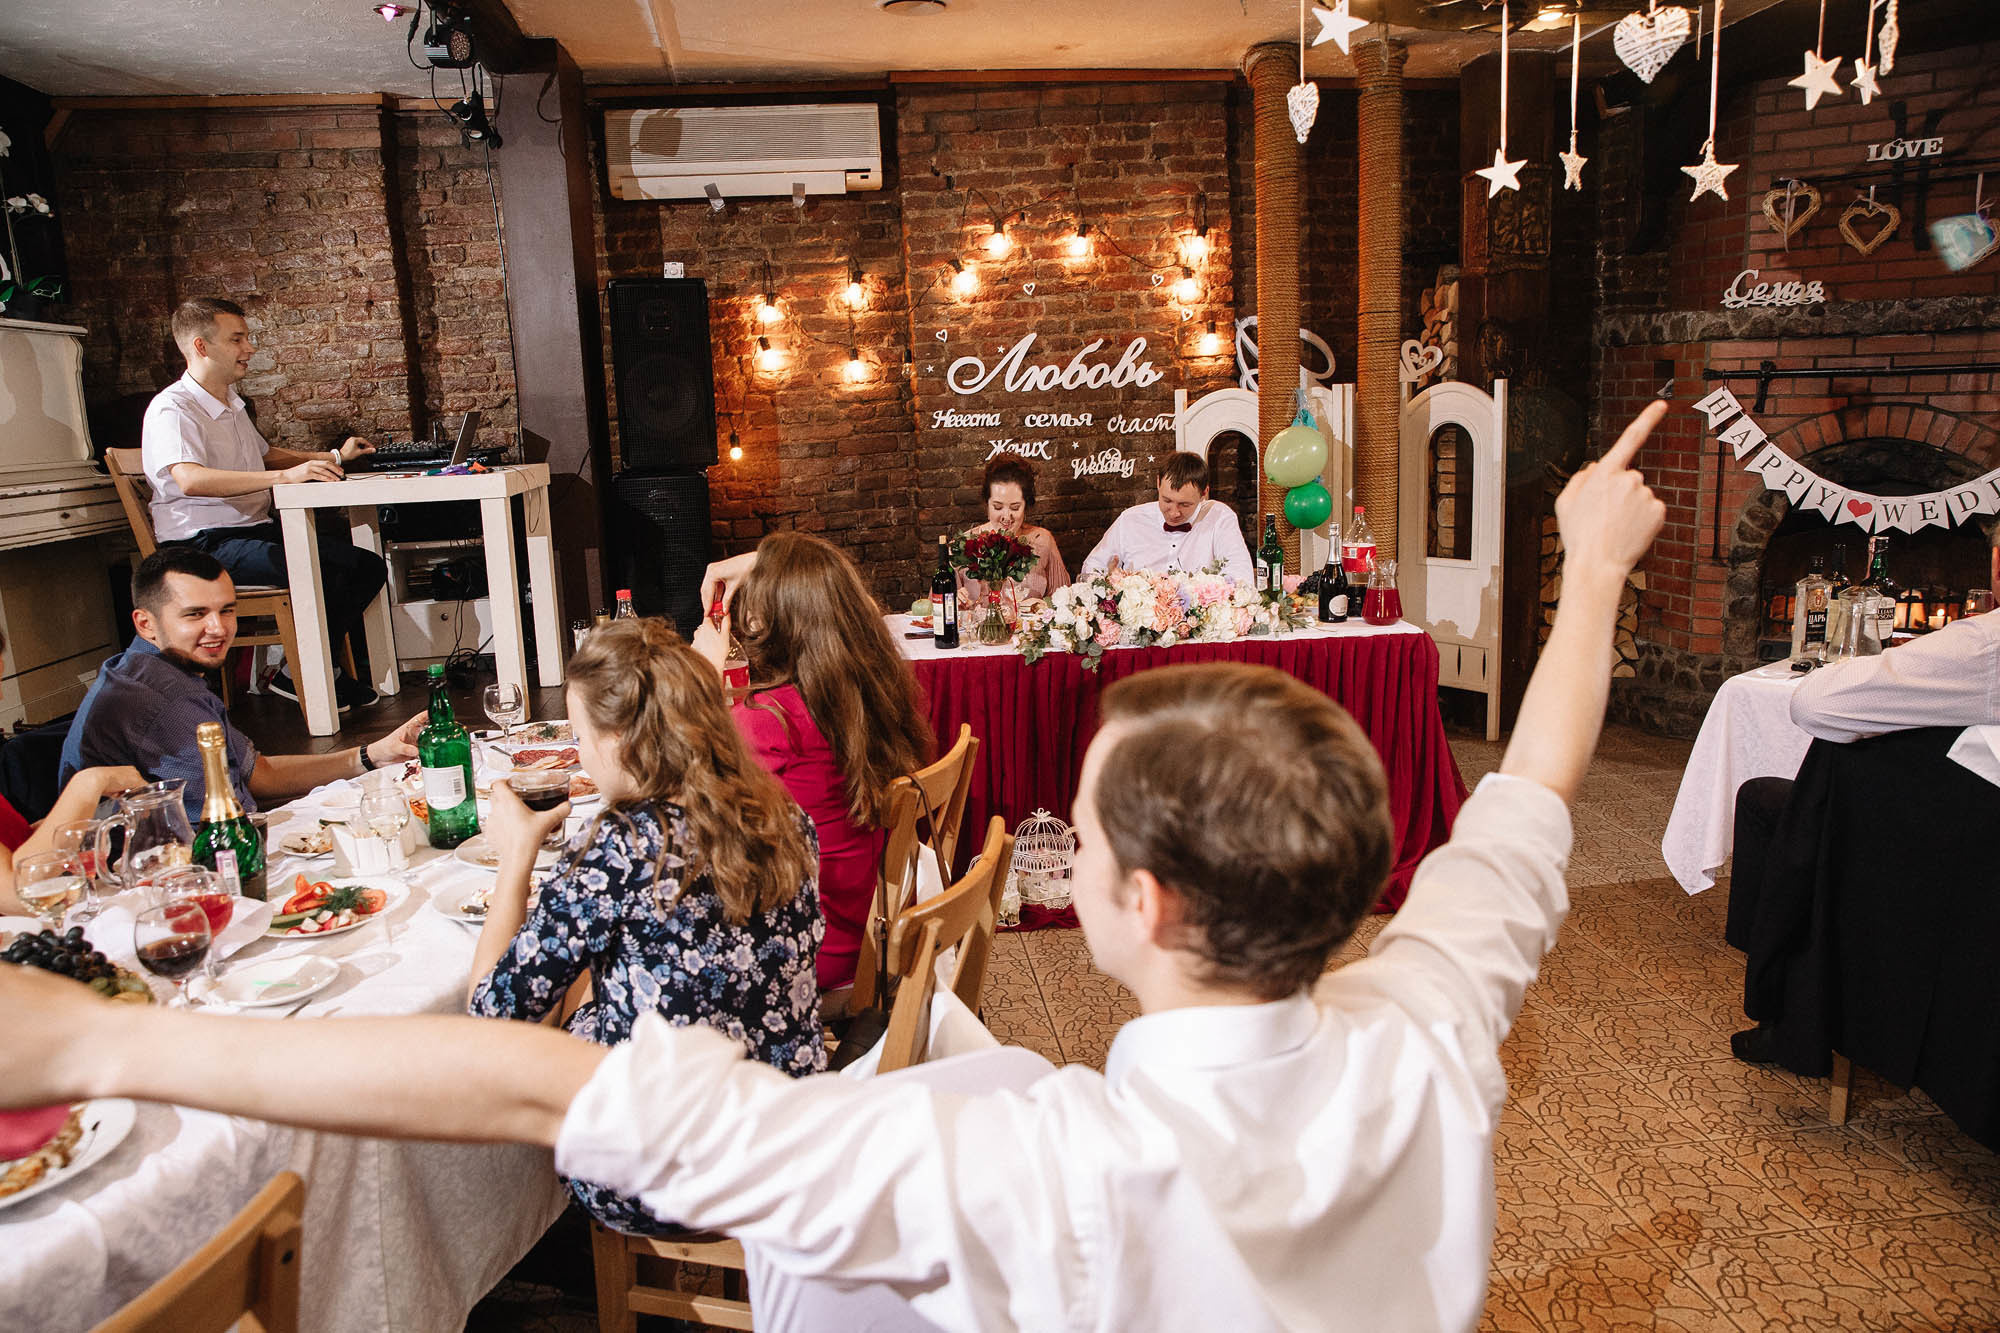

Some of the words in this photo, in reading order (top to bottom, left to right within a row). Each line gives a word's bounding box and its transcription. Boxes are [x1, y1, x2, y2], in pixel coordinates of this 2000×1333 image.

[1867, 137, 1945, 162] LOVE
[1722, 269, 1826, 307] Семья
[946, 332, 1165, 395] Любовь
[931, 408, 1001, 429] Невеста
[1024, 412, 1093, 428] семья
[985, 438, 1053, 461] Жених
[1071, 448, 1137, 480] Wedding
[1705, 394, 1838, 508] HAPPY
